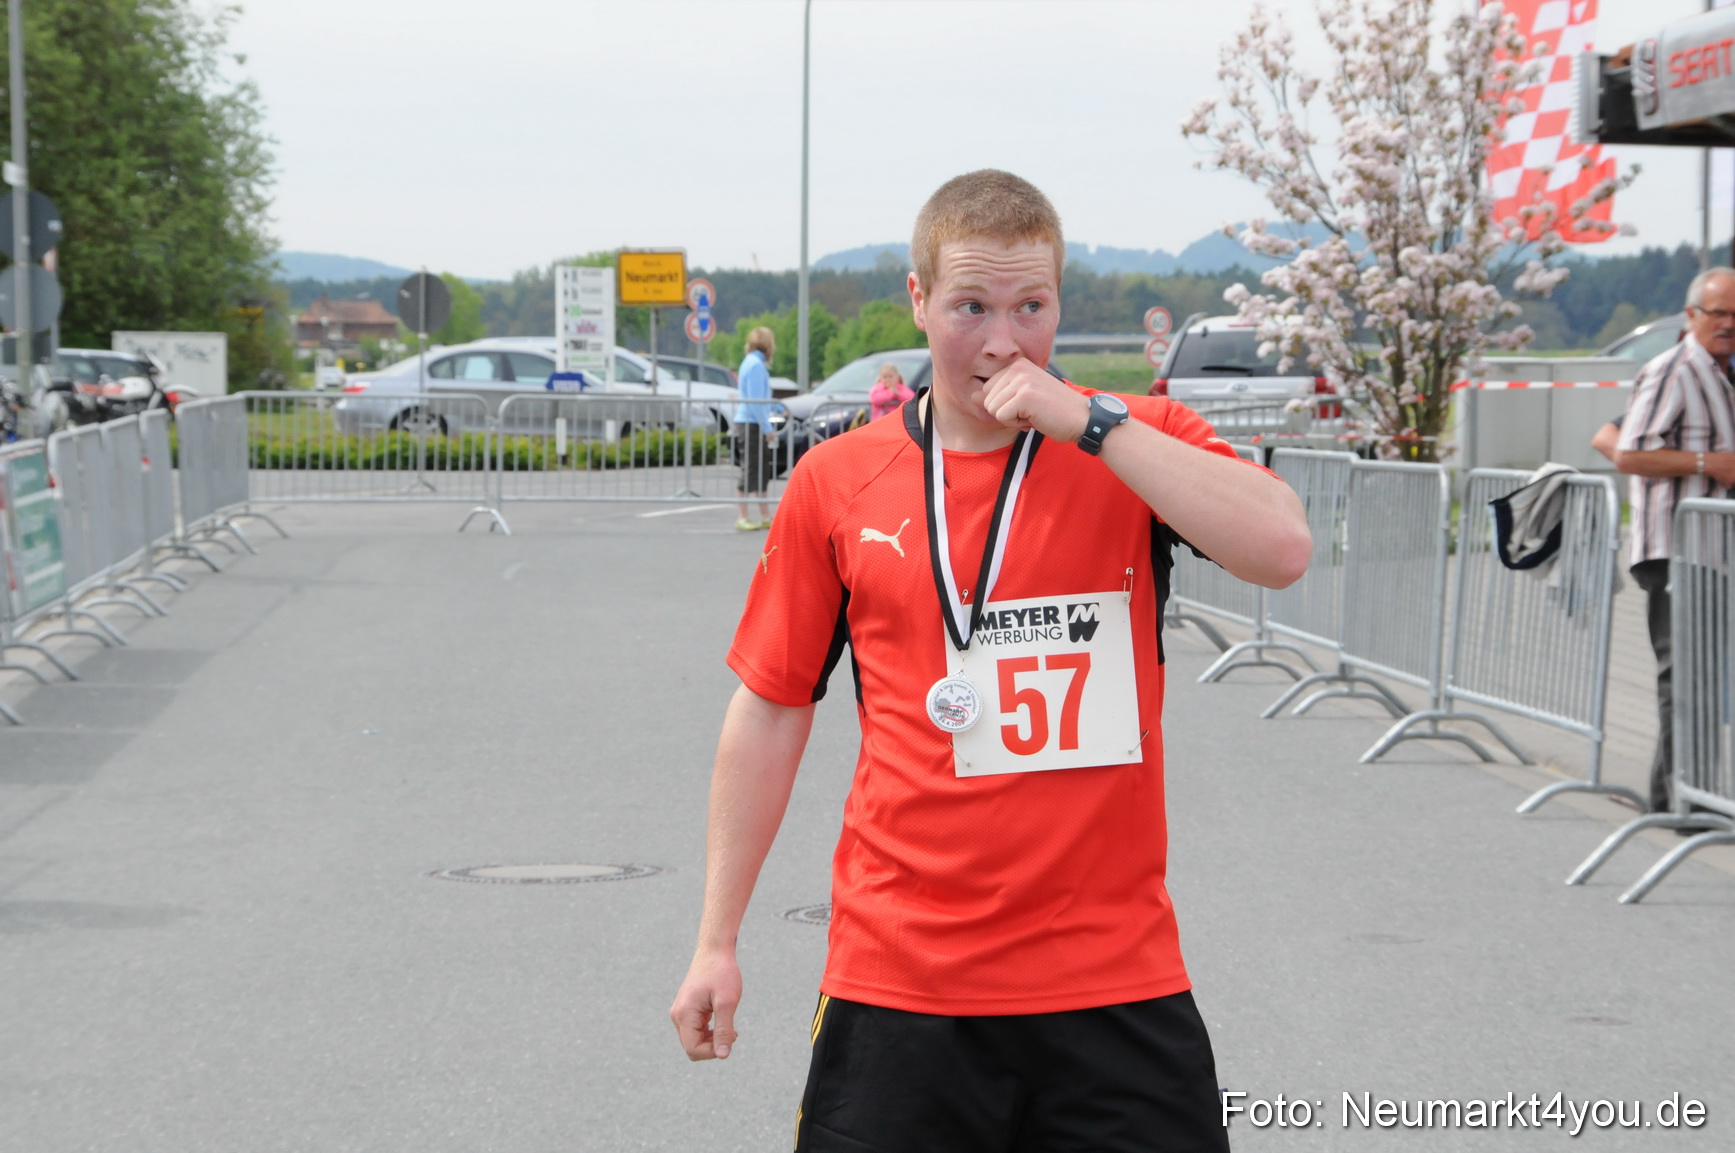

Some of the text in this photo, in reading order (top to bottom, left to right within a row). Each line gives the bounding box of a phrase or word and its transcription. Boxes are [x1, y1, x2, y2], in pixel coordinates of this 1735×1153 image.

[1668, 38, 1735, 88] SEAT
[625, 271, 680, 284] Neumarkt
[1153, 315, 1167, 329] 60
[976, 605, 1062, 632] MEYER
[976, 626, 1063, 647] WERBUNG
[997, 652, 1092, 756] 57
